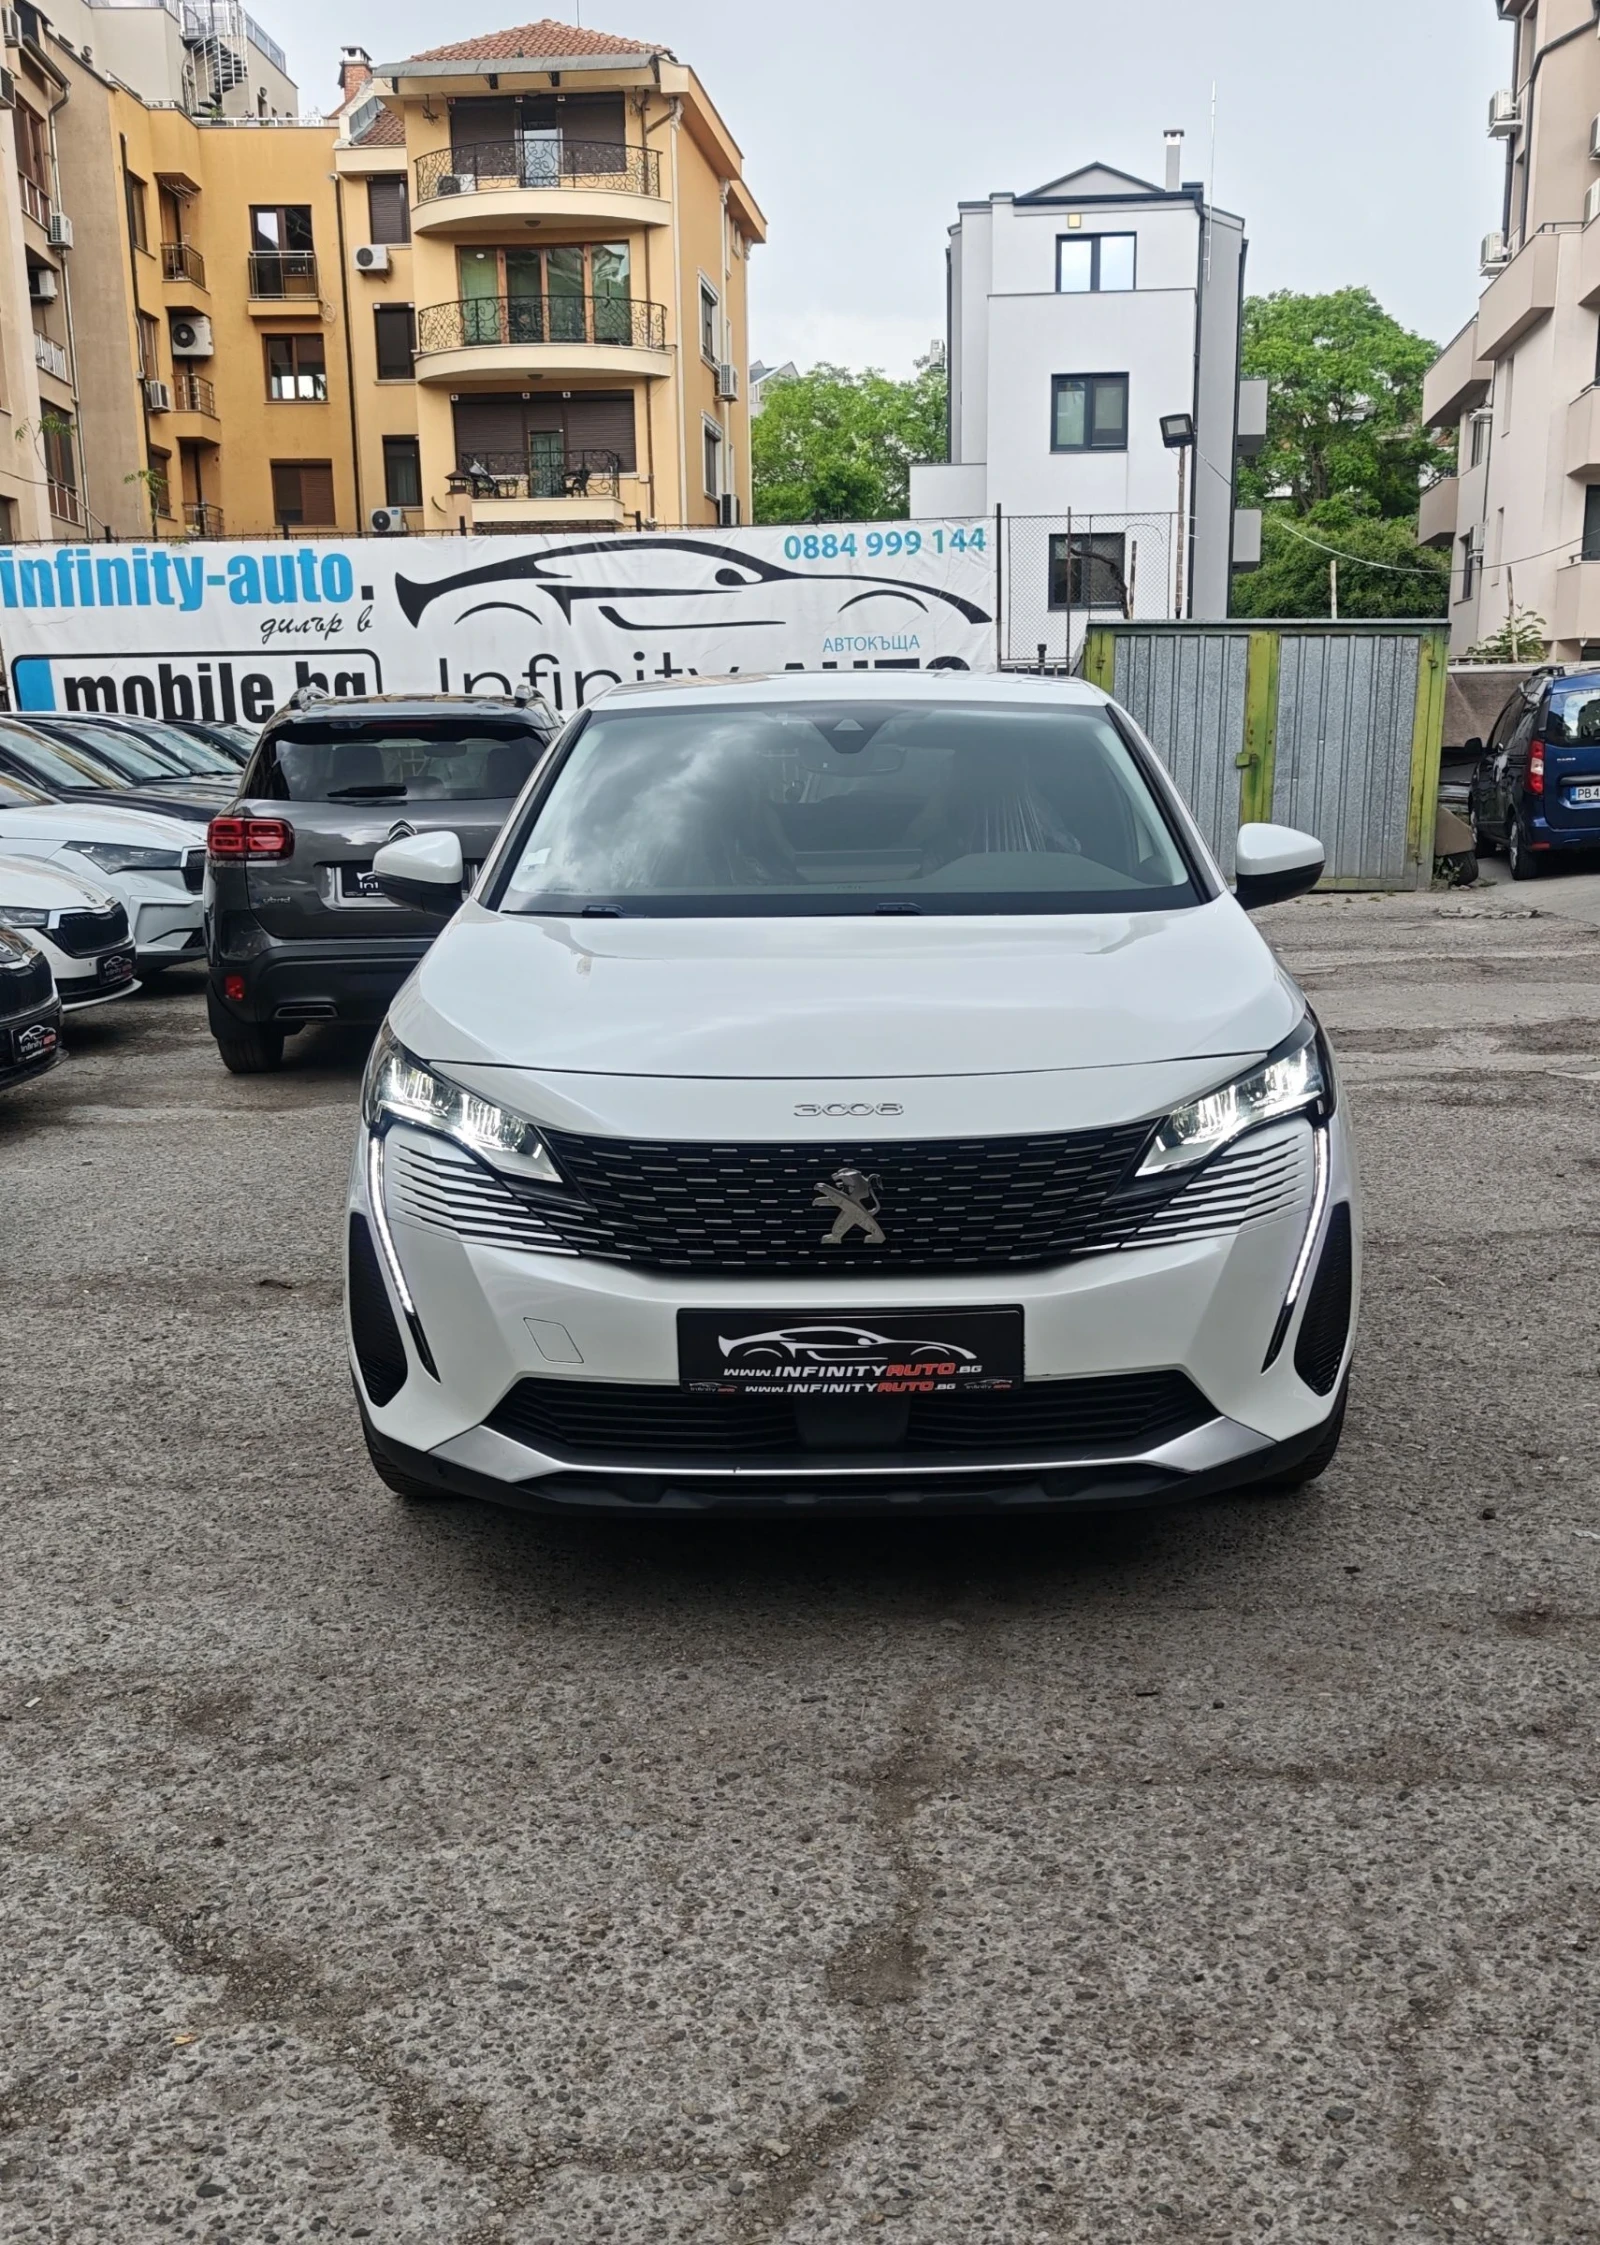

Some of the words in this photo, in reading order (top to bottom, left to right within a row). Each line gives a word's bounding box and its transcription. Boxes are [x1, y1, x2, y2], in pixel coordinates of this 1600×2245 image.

[783, 532, 858, 560] 0884
[865, 530, 922, 557] 999
[932, 527, 987, 554] 144
[260, 612, 345, 645] дилър
[822, 634, 921, 653] АВТОКЪЩА
[793, 1102, 905, 1117] 3008
